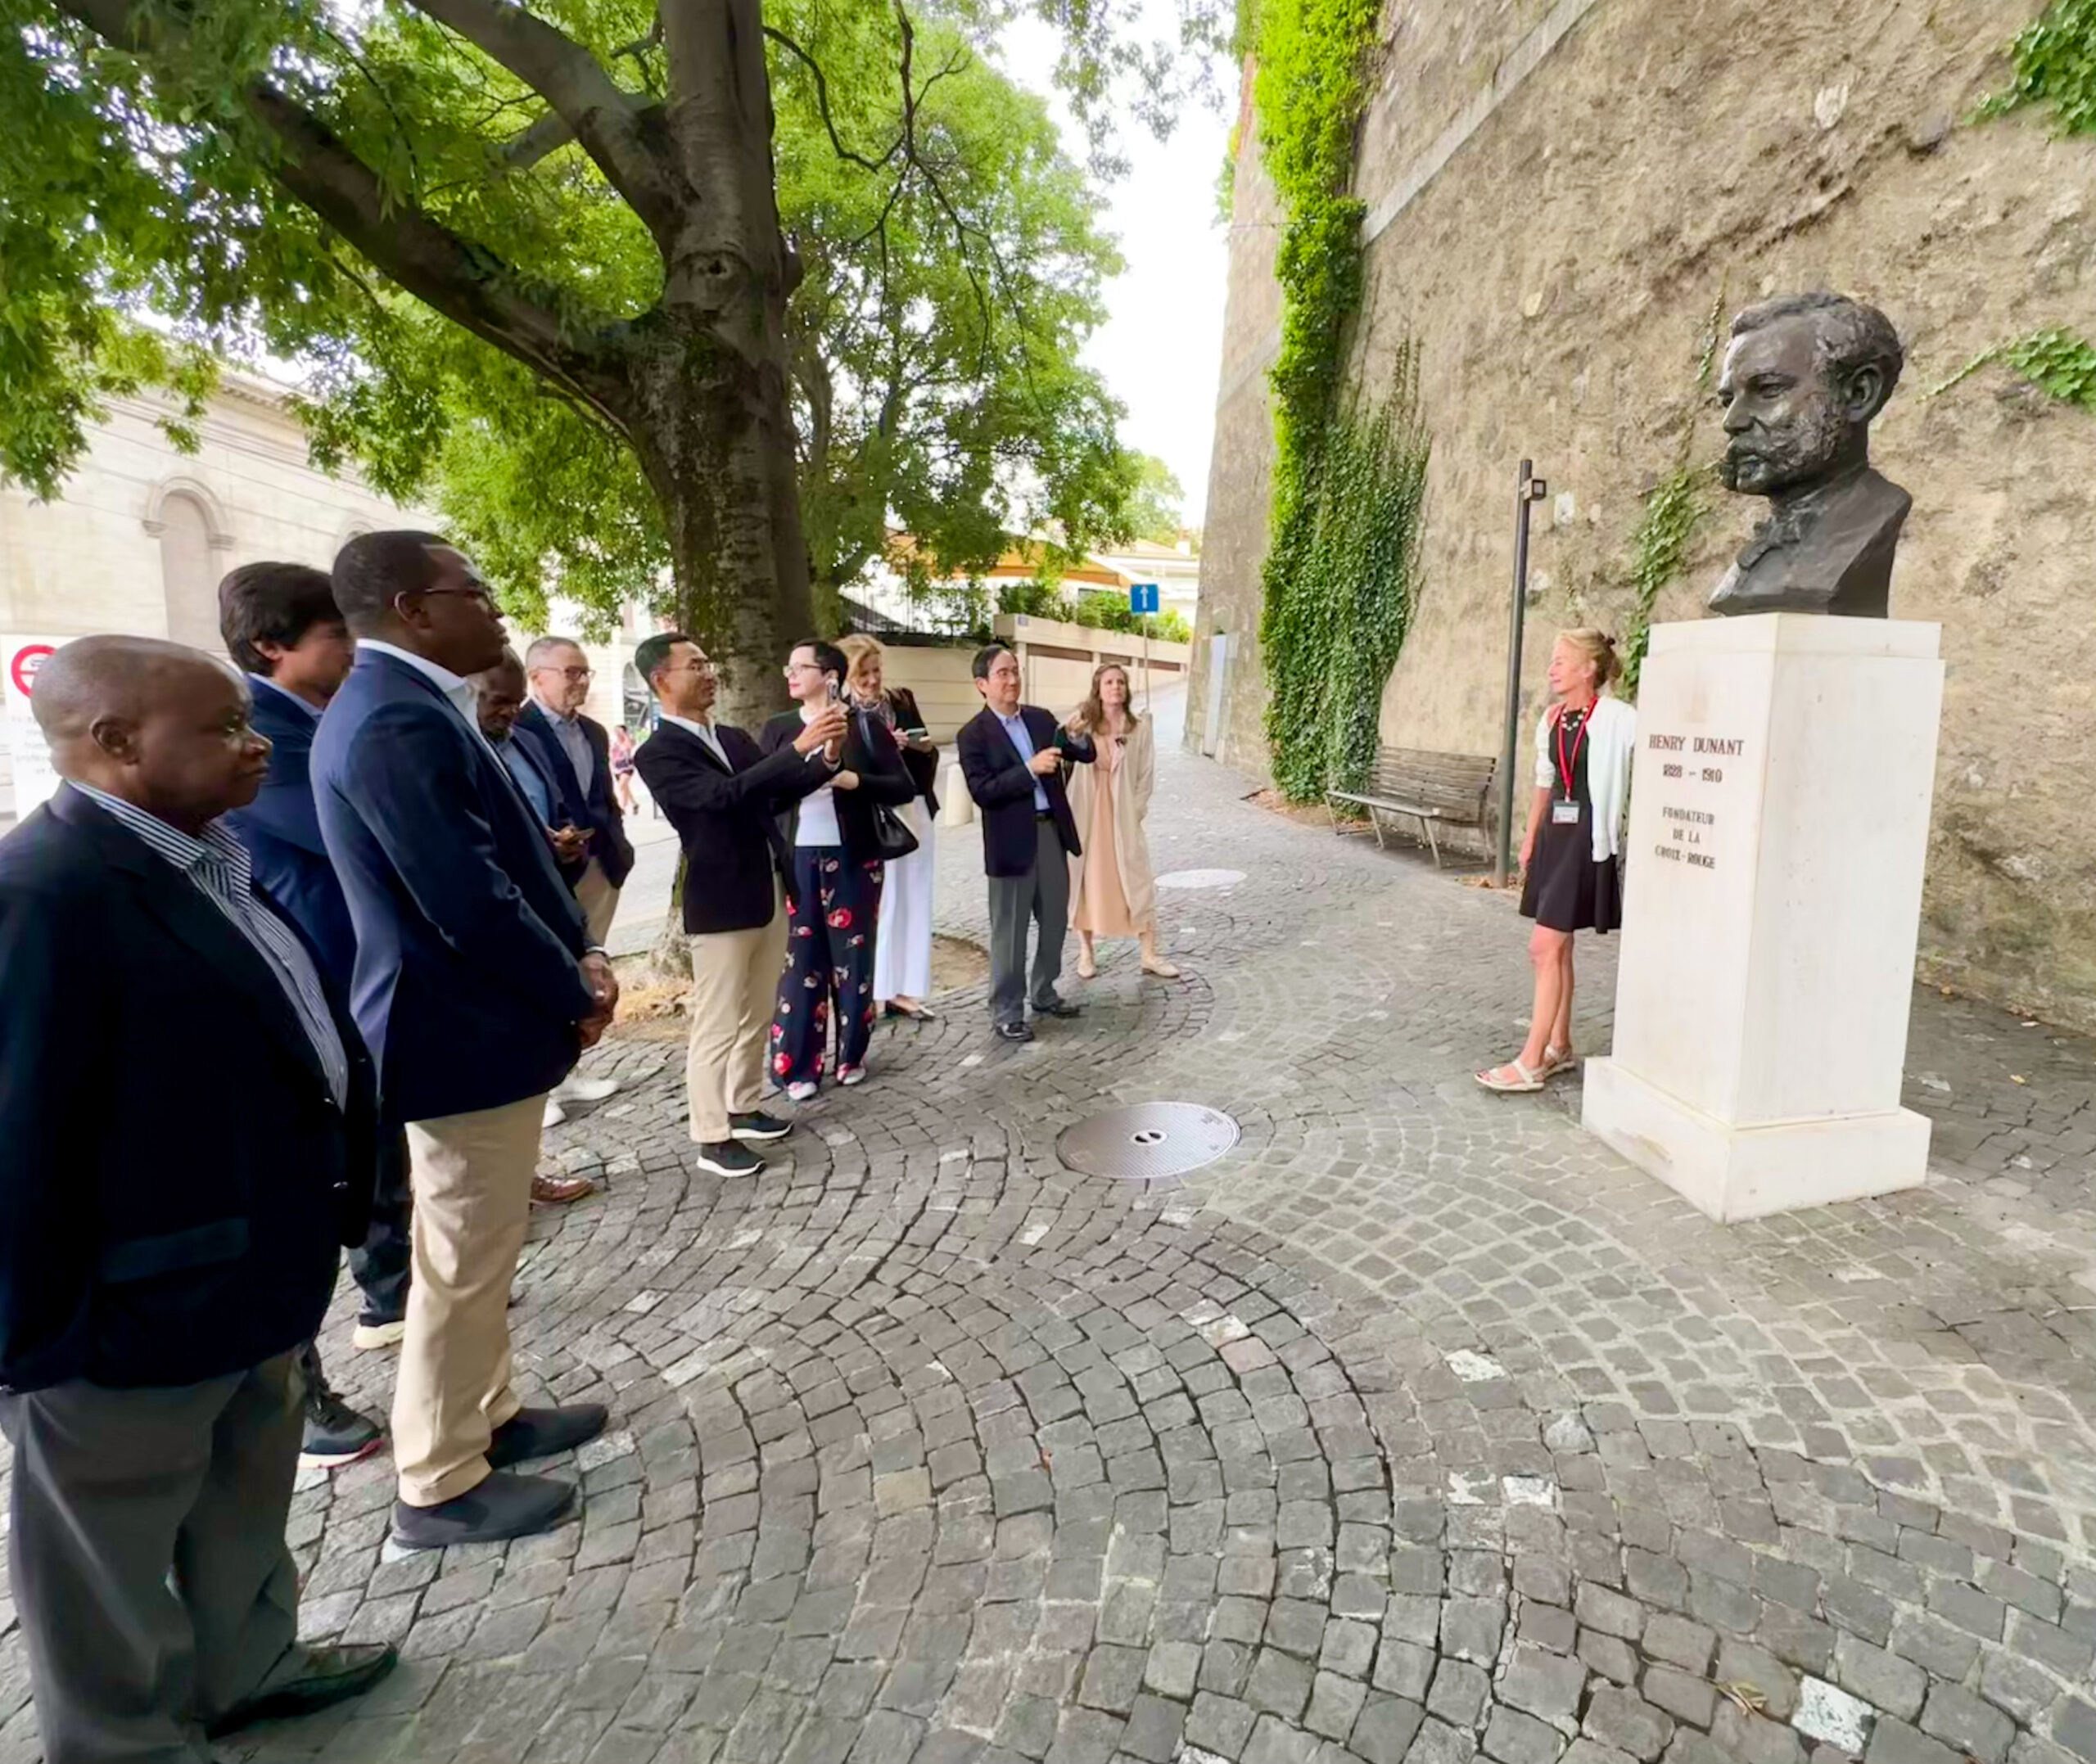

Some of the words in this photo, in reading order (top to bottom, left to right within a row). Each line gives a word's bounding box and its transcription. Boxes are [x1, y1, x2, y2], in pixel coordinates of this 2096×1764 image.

[1649, 734, 1686, 751] HENRY
[1693, 738, 1744, 756] DUNANT
[1663, 764, 1683, 778] 1828
[1702, 767, 1723, 783] 1910
[1662, 806, 1715, 825] FONDATEUR
[1673, 828, 1684, 841] DE
[1688, 831, 1701, 844] LA
